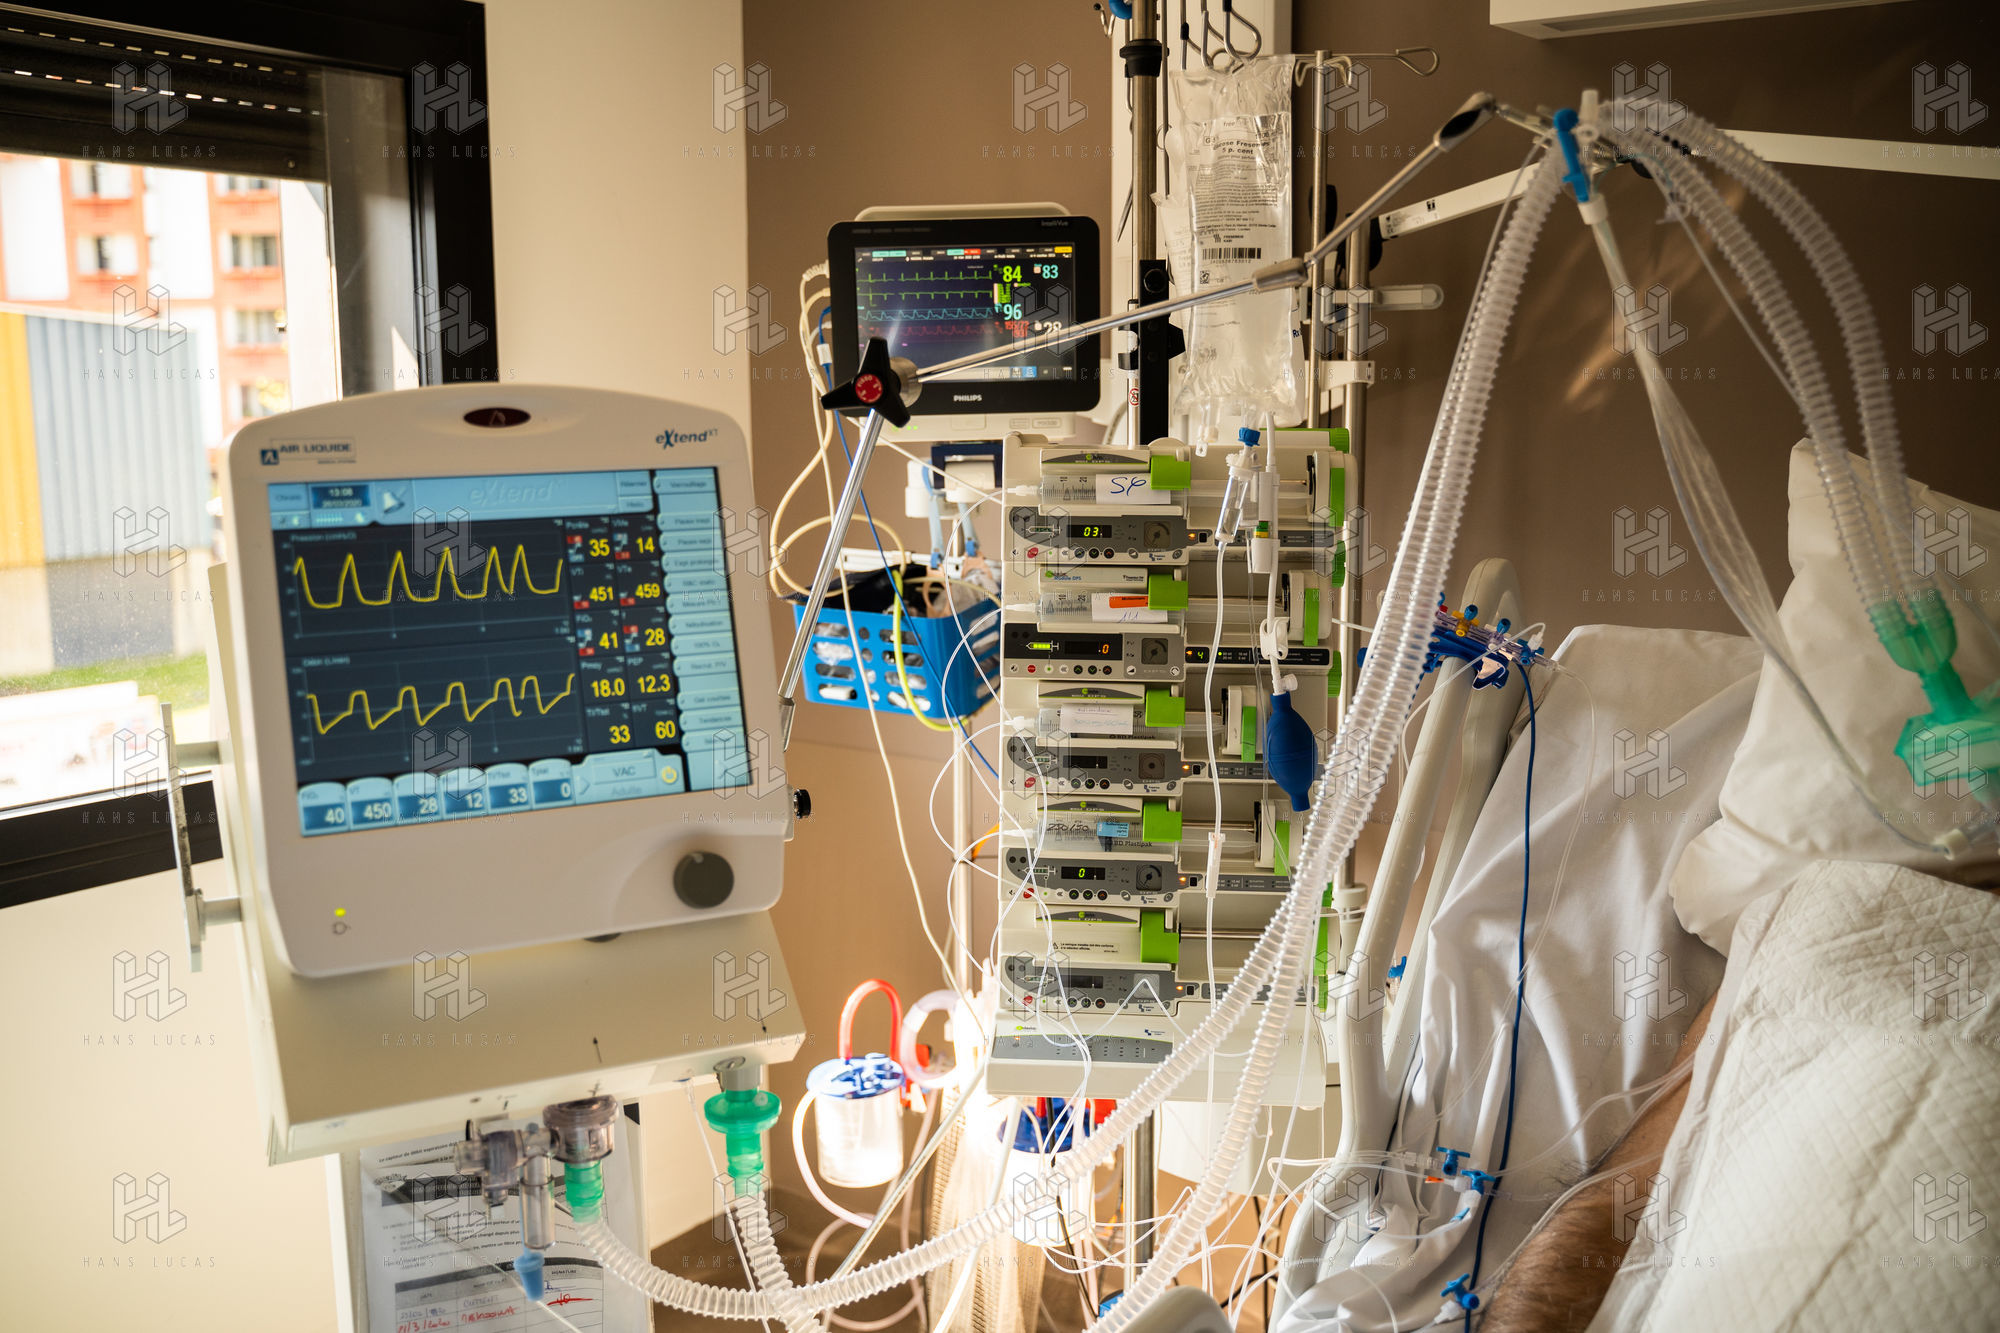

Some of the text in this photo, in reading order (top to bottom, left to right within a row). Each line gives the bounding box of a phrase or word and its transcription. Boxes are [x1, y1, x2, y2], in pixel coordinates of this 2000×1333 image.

[1002, 265, 1022, 283] 84
[1042, 264, 1059, 280] 83
[1003, 303, 1023, 321] 96
[953, 394, 983, 402] PHILIPS
[280, 444, 299, 454] AIR
[589, 538, 610, 557] 35
[636, 536, 655, 554] 14
[589, 585, 614, 602] 451
[635, 582, 661, 598] 459
[598, 631, 618, 649] 41
[644, 627, 666, 646] 28
[591, 677, 625, 698] 18.0
[637, 673, 671, 694] 12.3
[609, 724, 631, 744] 33
[655, 720, 676, 739] 60
[612, 766, 636, 777] VAC
[508, 786, 528, 803] 33
[560, 781, 571, 798] 0
[418, 797, 438, 814] 28
[465, 791, 484, 808] 12
[325, 806, 345, 825] 40
[363, 801, 392, 820] 450
[1078, 867, 1086, 879] 0
